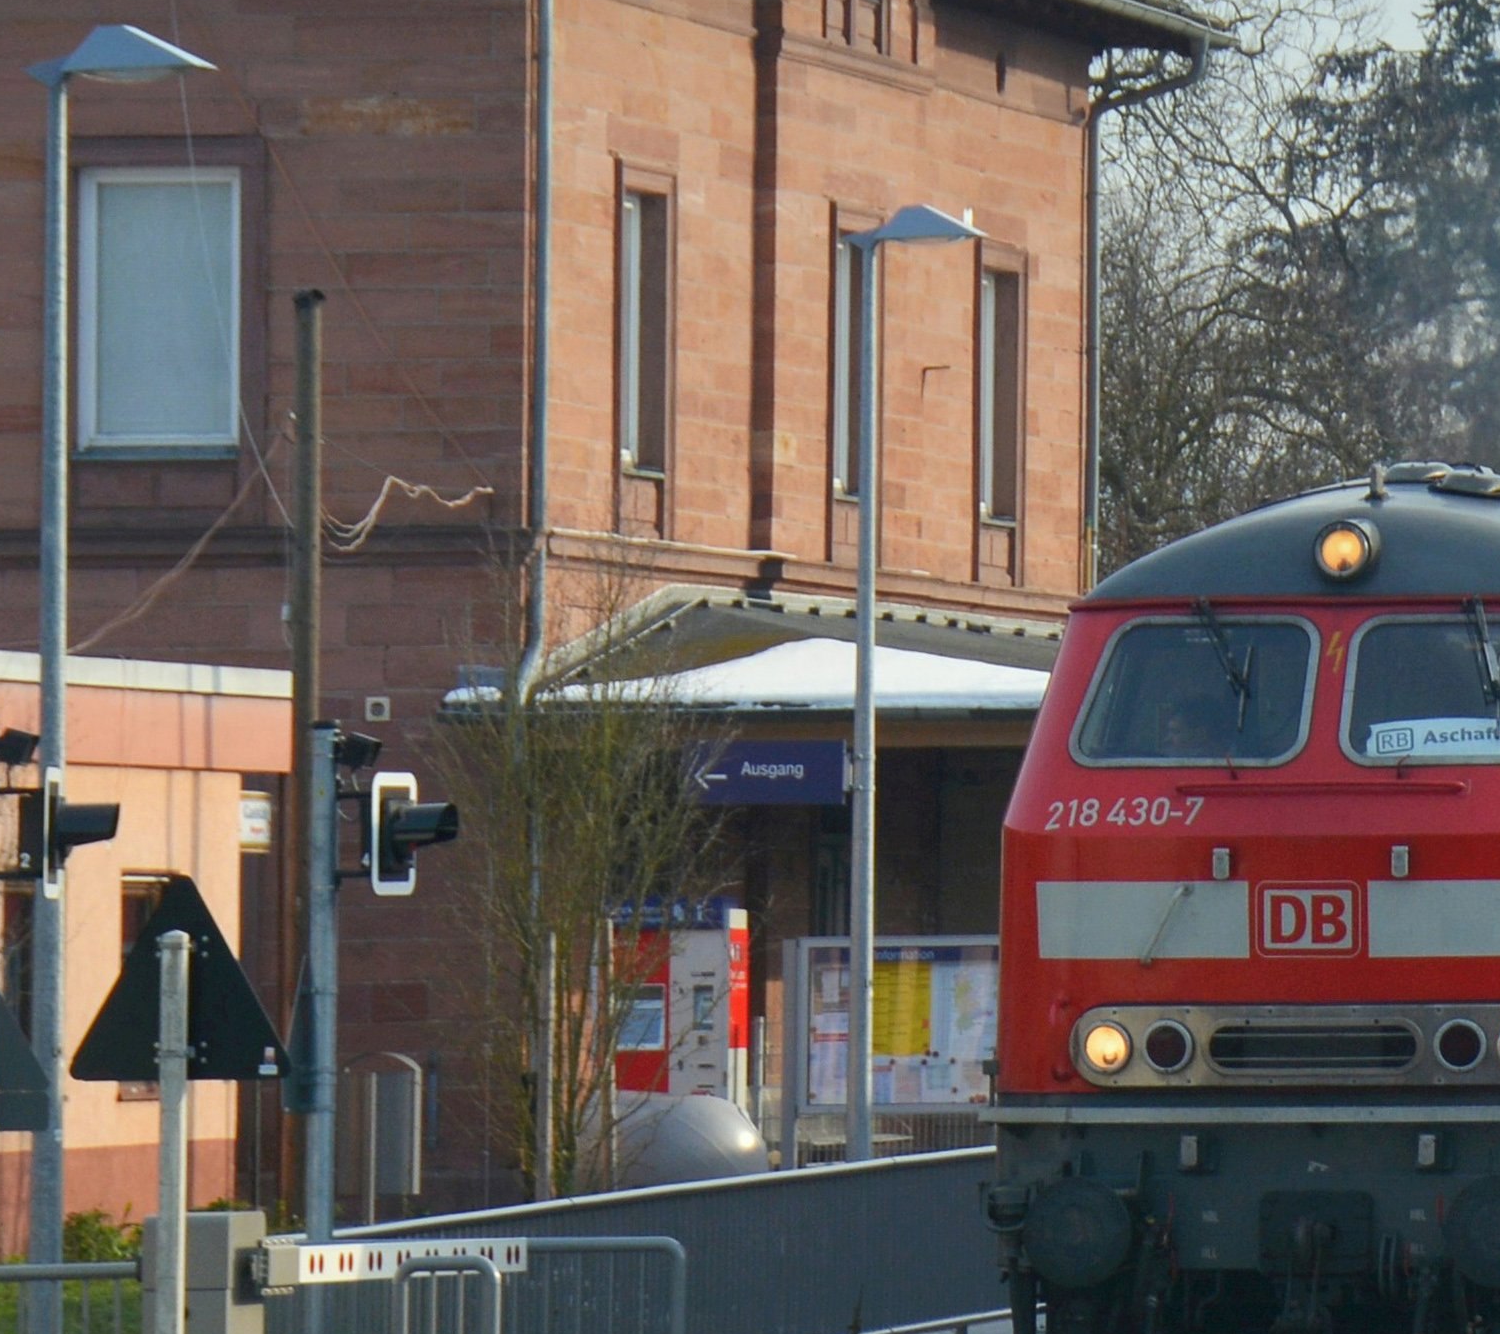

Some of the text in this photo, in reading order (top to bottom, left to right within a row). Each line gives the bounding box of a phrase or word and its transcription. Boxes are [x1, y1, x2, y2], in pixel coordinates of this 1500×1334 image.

[1380, 732, 1410, 750] RB
[740, 761, 804, 779] Ausgang
[1044, 796, 1204, 831] 218 430-7
[1270, 895, 1347, 944] DB
